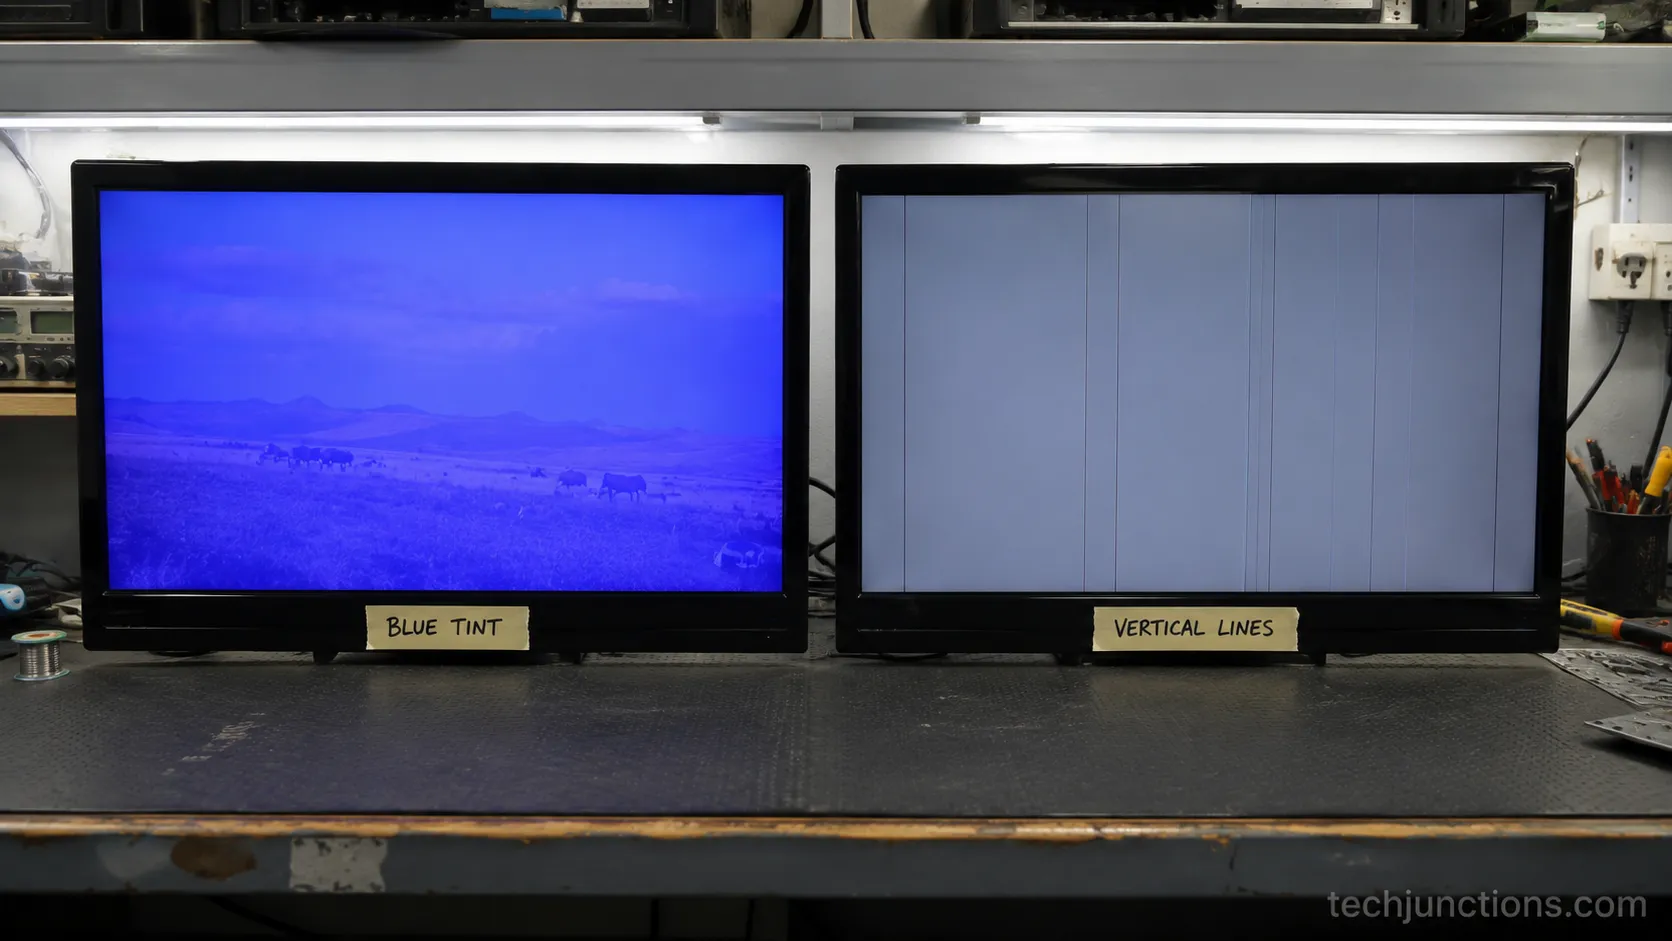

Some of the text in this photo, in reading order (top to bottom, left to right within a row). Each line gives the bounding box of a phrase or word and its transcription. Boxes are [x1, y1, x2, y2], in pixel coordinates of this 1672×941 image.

[386, 616, 503, 637] BLUE TINT
[1114, 617, 1274, 638] VERTICAL LINES
